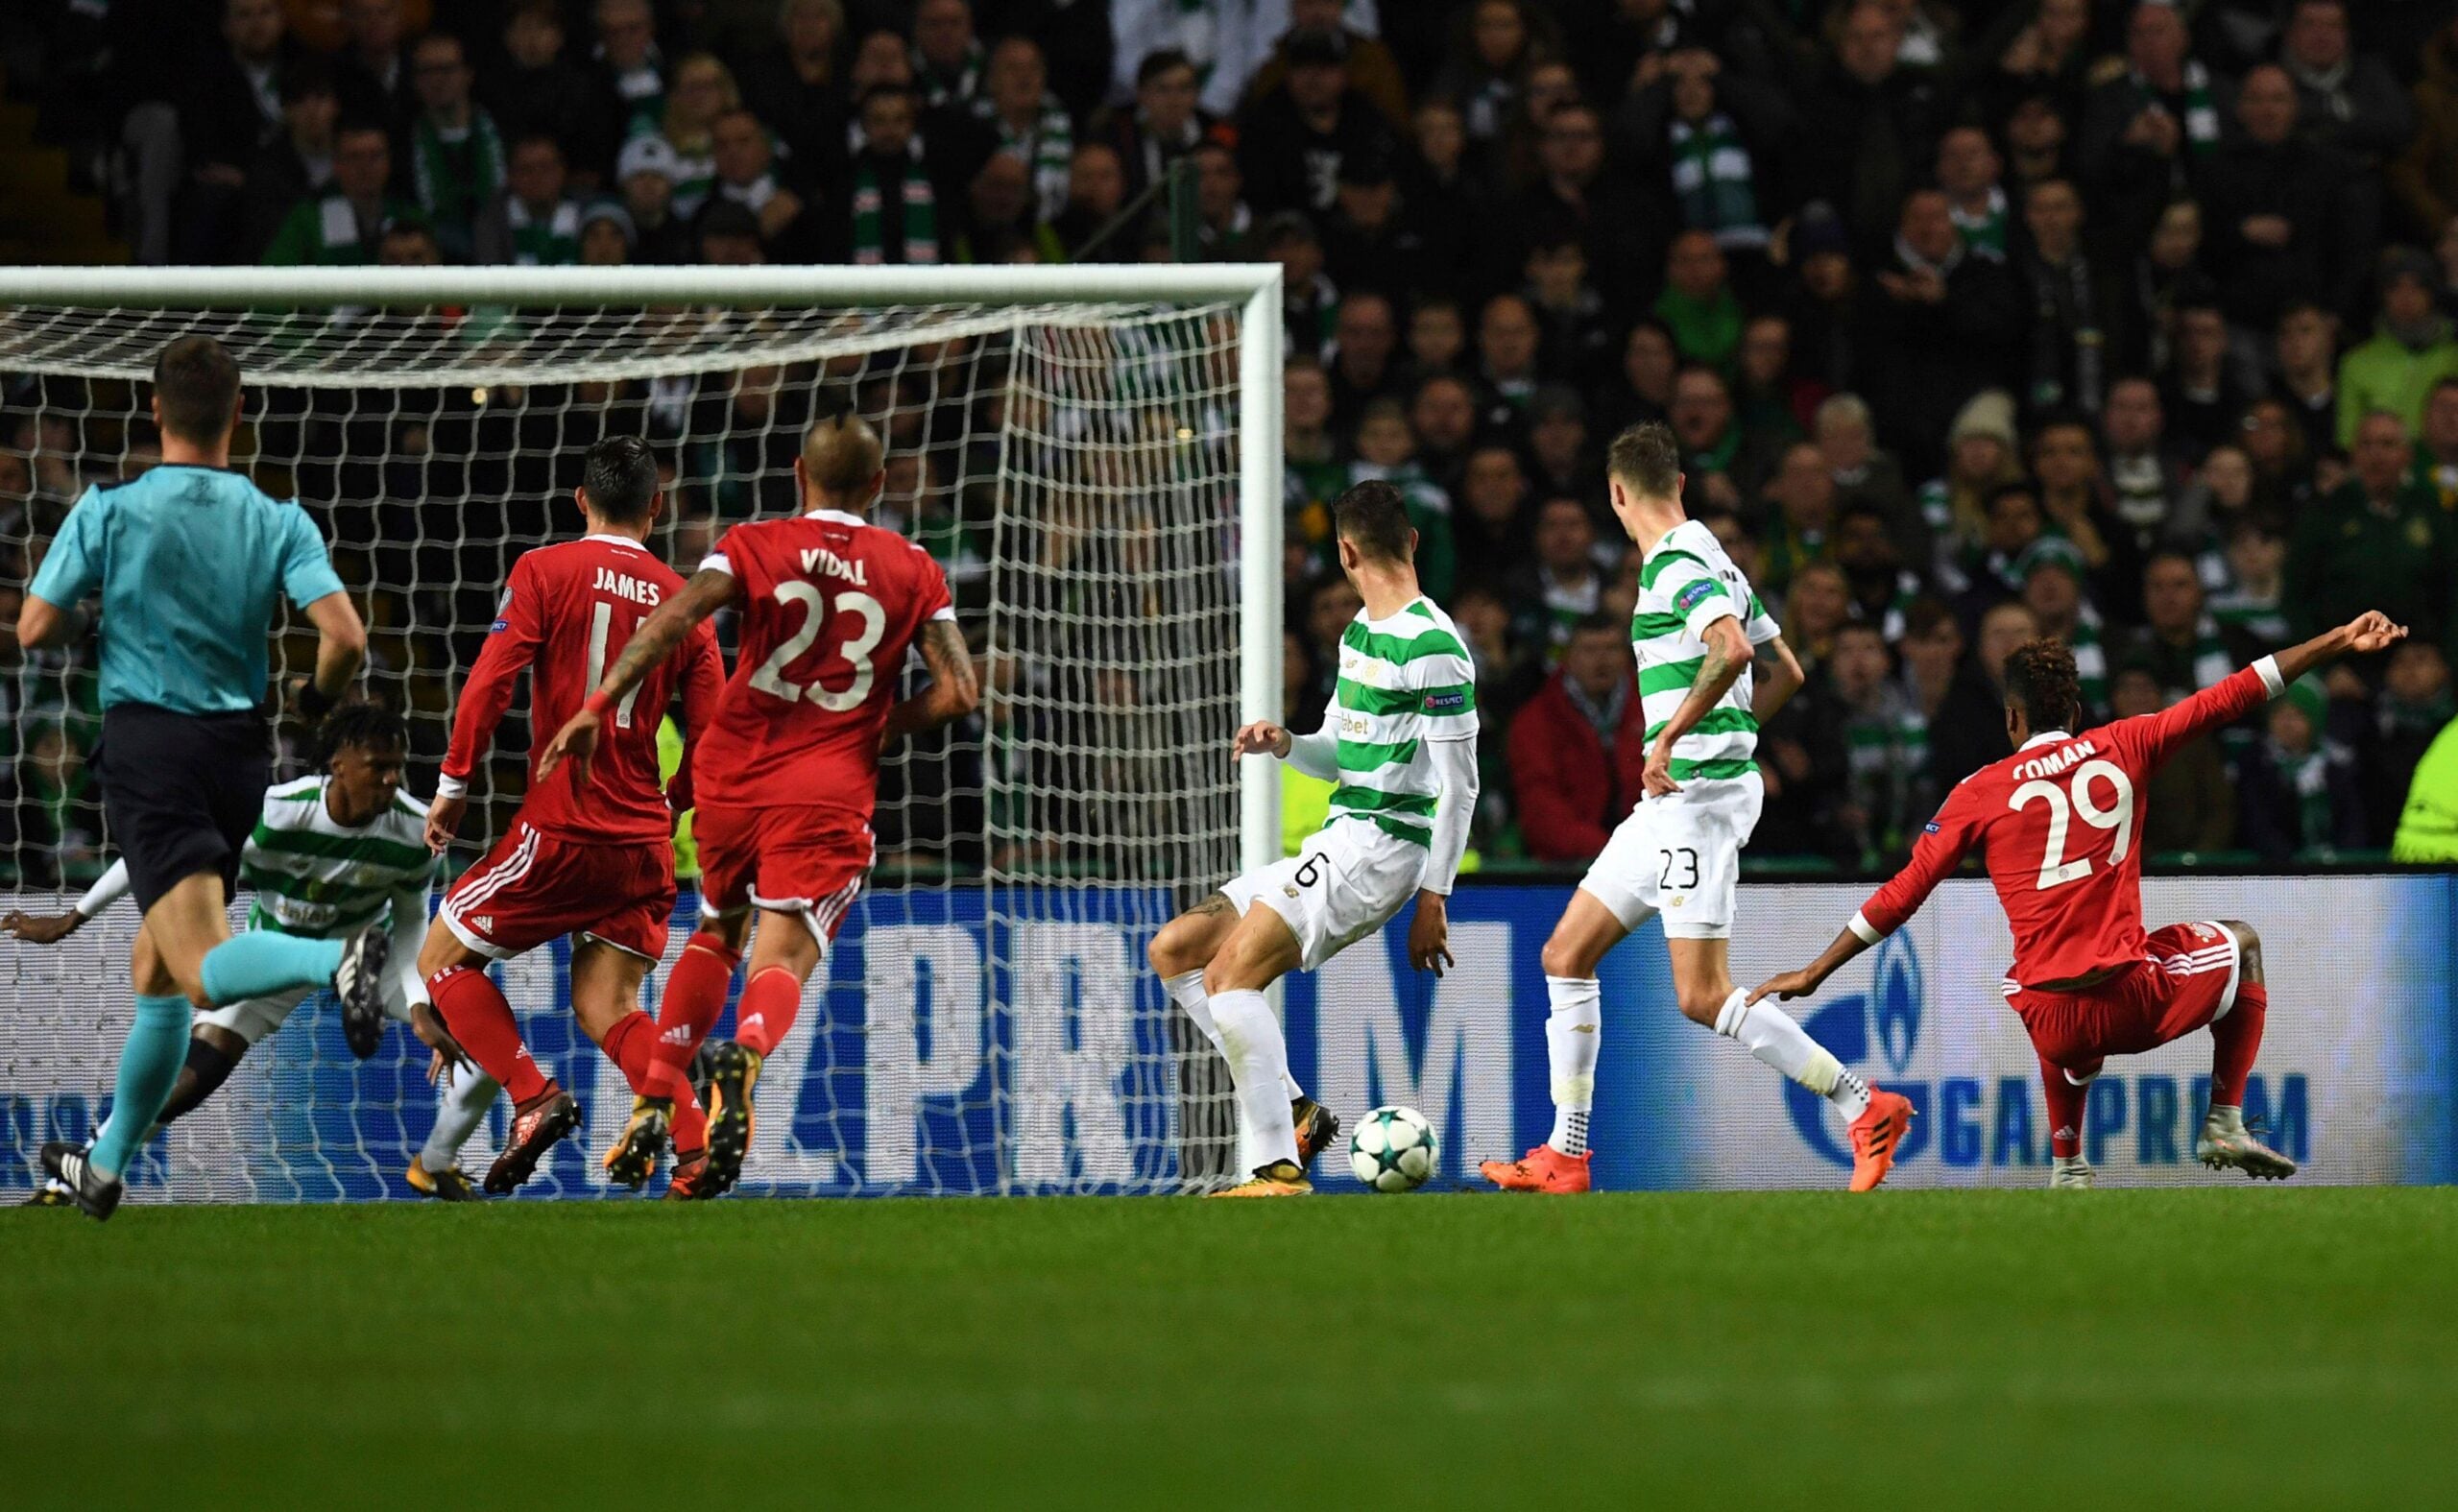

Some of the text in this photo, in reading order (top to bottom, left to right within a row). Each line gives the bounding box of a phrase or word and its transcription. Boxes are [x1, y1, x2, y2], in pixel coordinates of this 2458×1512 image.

[591, 565, 662, 608] JAMES
[799, 547, 869, 587] VIDAL
[747, 579, 887, 712] 23
[1434, 696, 1464, 707] RESPECT
[2012, 739, 2098, 781] COMAN
[2007, 758, 2134, 892] 29
[1294, 852, 1331, 888] 6
[1659, 847, 1700, 891] 23
[1940, 1074, 2310, 1167] GAPRM
